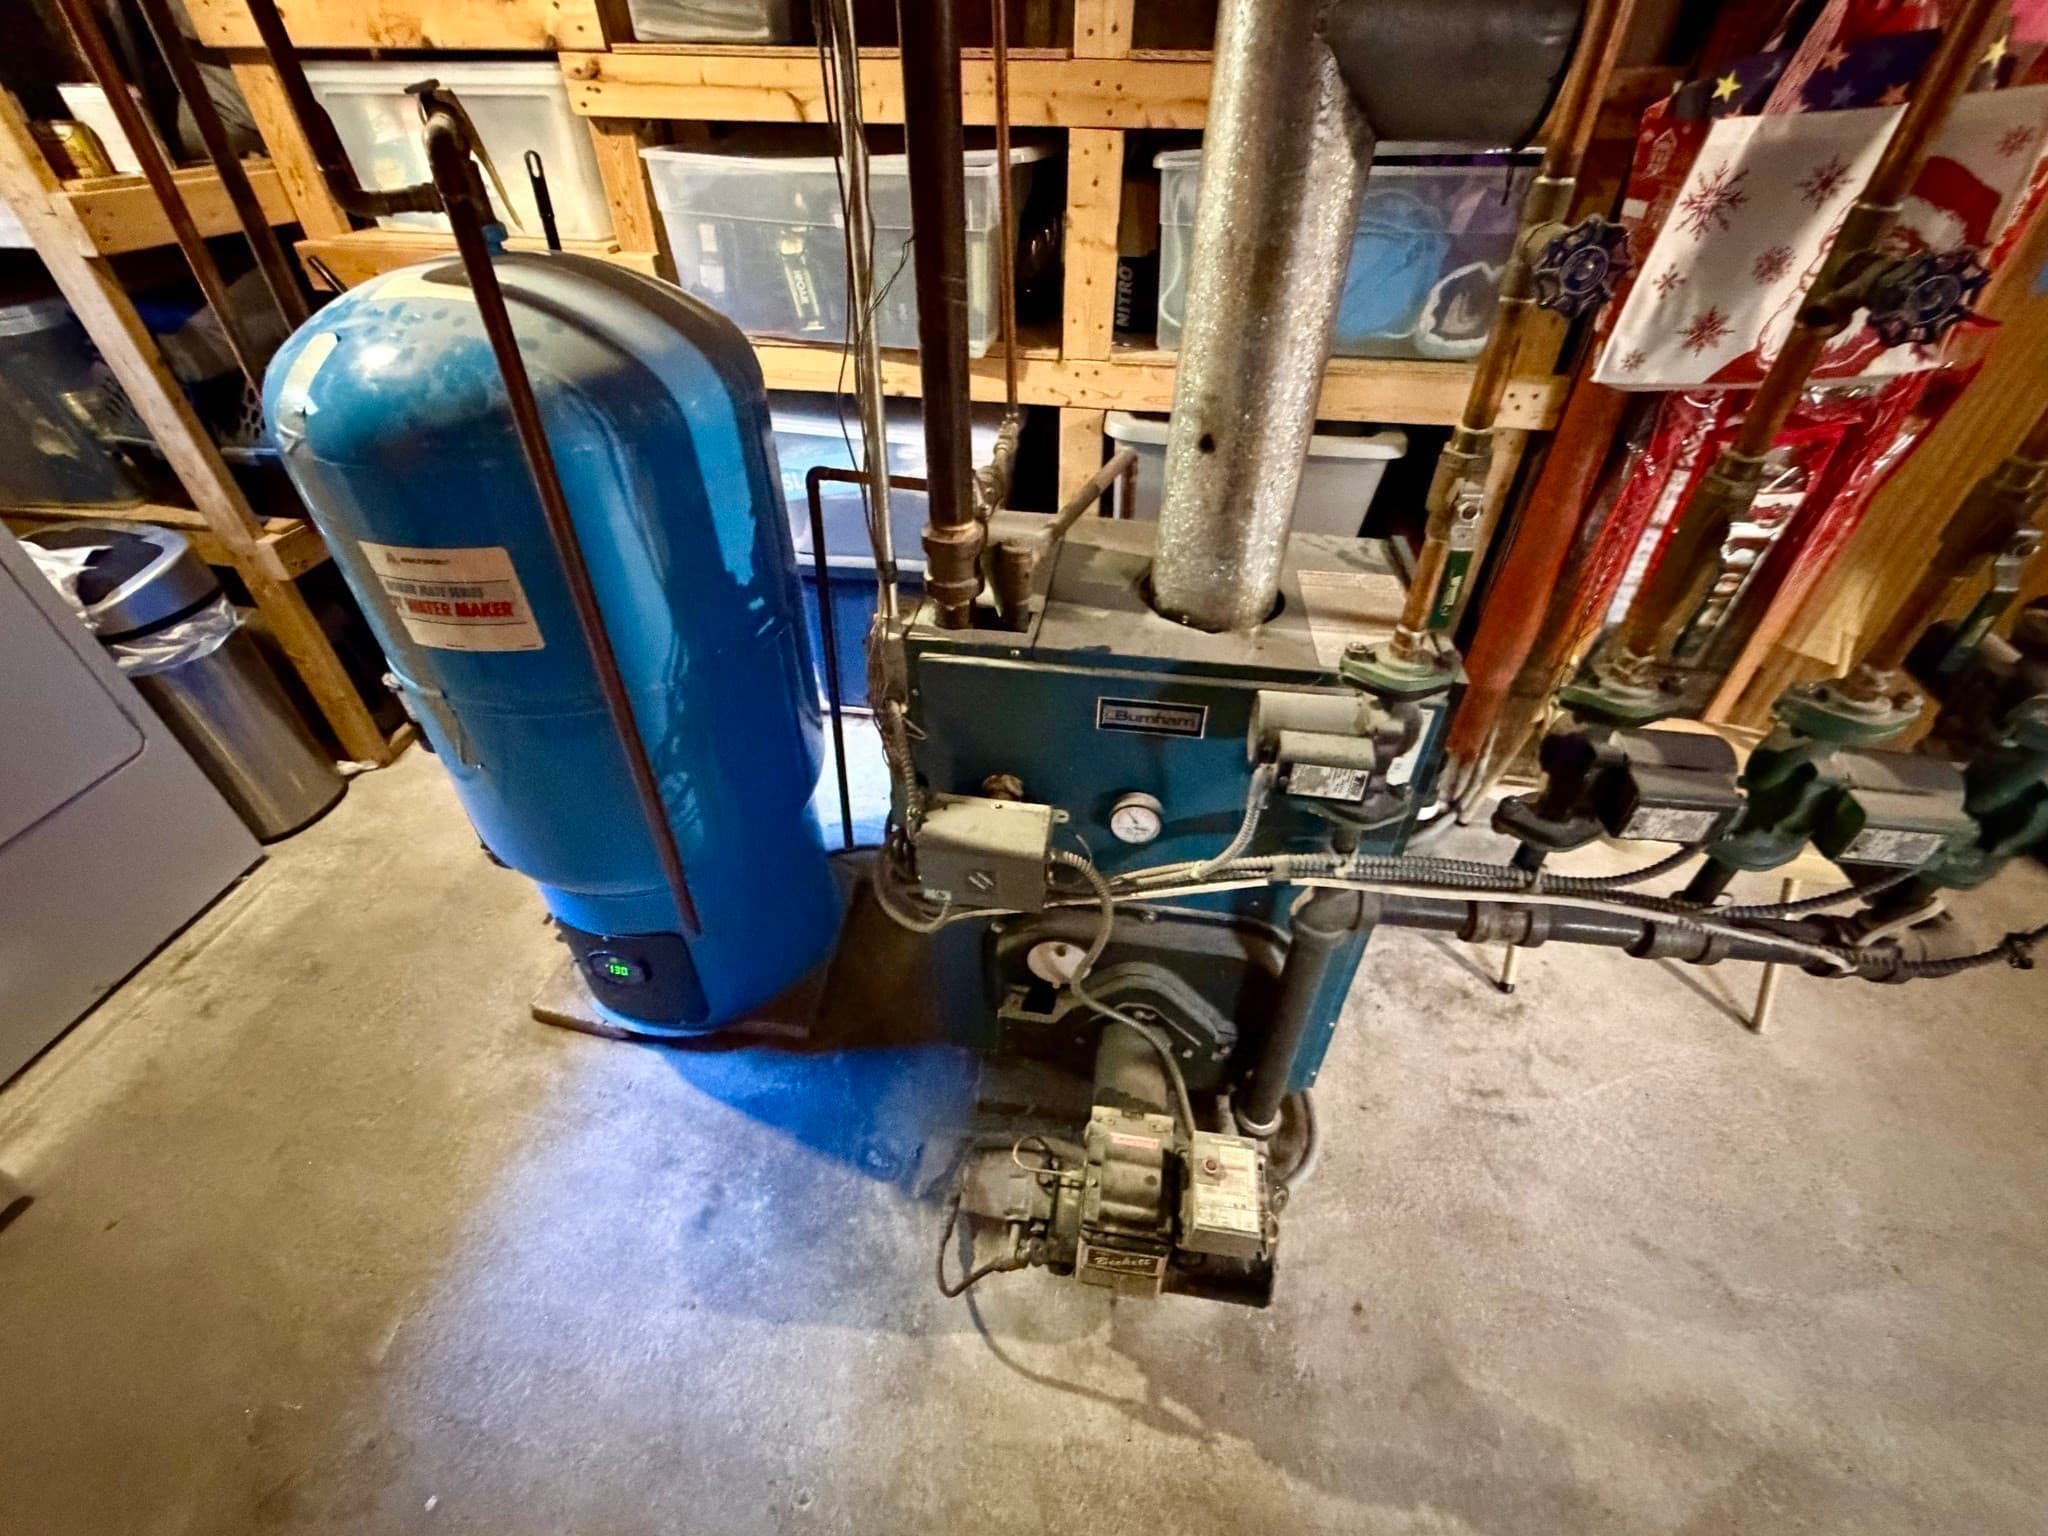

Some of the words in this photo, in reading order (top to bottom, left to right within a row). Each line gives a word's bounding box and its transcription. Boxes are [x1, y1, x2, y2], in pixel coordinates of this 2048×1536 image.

[1115, 265, 1134, 328] NITRO
[403, 597, 454, 617] WATER
[455, 601, 514, 618] MAKER
[1114, 709, 1197, 729] Burnham
[609, 964, 629, 977] 130
